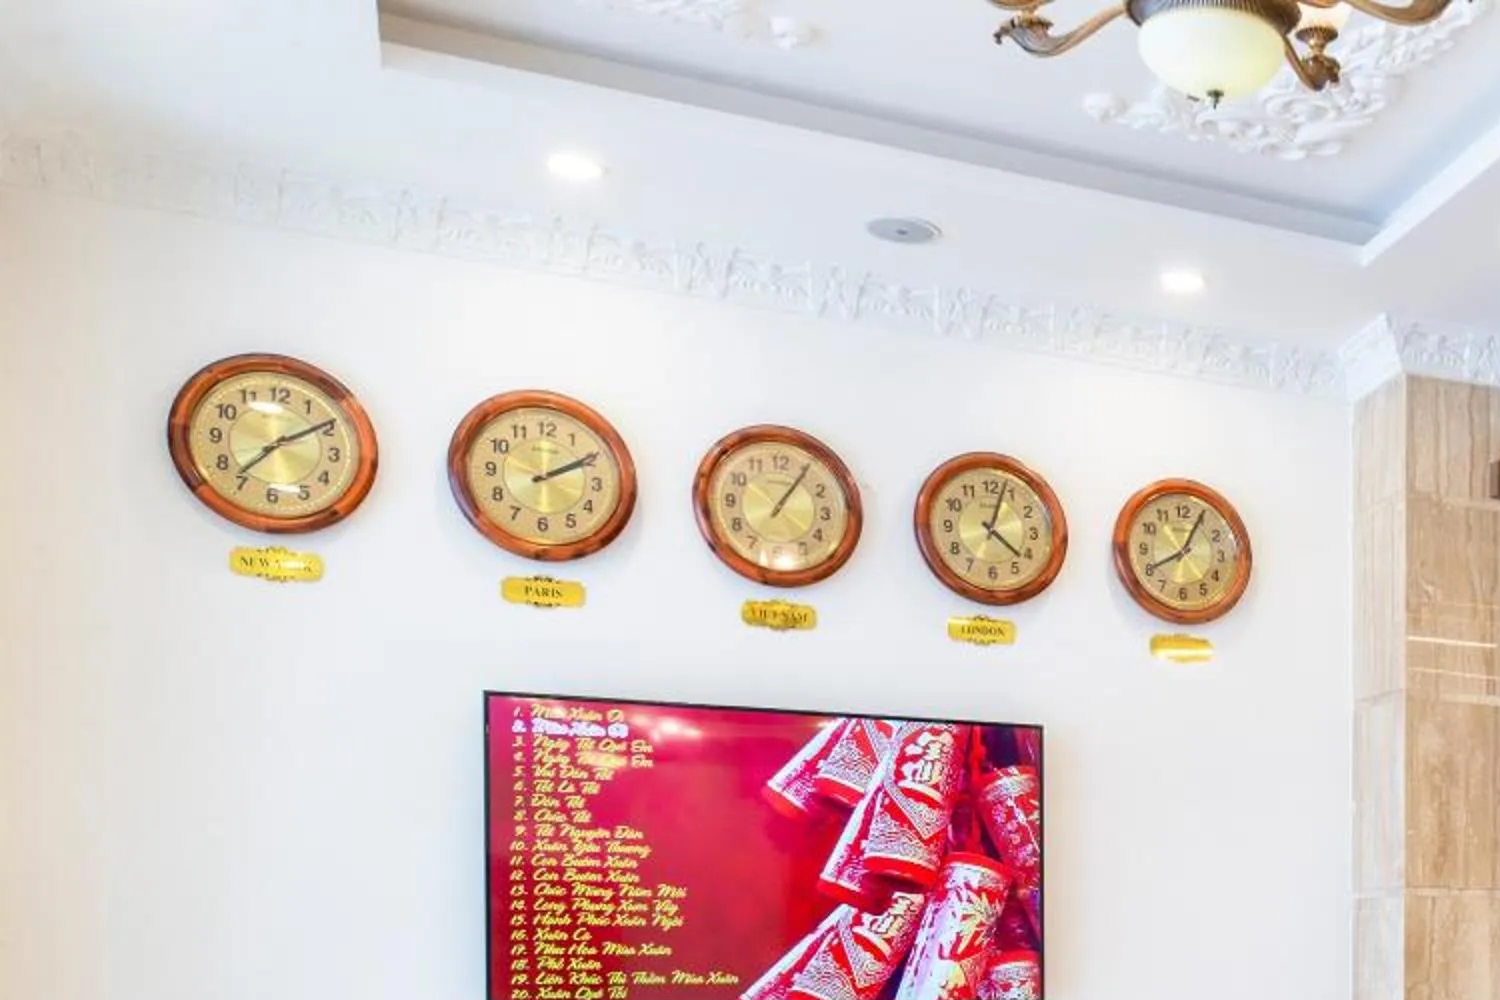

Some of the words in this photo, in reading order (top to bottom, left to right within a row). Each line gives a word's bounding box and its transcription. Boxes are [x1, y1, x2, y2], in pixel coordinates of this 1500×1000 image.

[240, 389, 257, 405] 11
[270, 387, 291, 404] 12
[216, 404, 237, 421] 10
[305, 400, 312, 415] 1
[322, 420, 337, 436] 2
[512, 424, 527, 439] 11
[537, 422, 558, 437] 12
[209, 427, 223, 444] 9
[568, 433, 576, 446] 1
[490, 438, 509, 454] 10
[328, 447, 341, 463] 3
[216, 454, 229, 471] 8
[485, 461, 497, 476] 9
[749, 458, 763, 472] 11
[771, 455, 790, 470] 12
[236, 475, 249, 491] 7
[318, 471, 330, 485] 4
[592, 477, 603, 492] 3
[731, 472, 748, 487] 10
[298, 485, 310, 500] 5
[492, 486, 504, 502] 8
[815, 484, 826, 499] 2
[962, 485, 976, 498] 11
[982, 480, 999, 495] 12
[1007, 487, 1015, 500] 1
[266, 487, 279, 503] 6
[725, 493, 736, 508] 9
[583, 500, 594, 514] 4
[946, 498, 962, 512] 10
[1023, 505, 1033, 519] 2
[509, 506, 522, 520] 7
[820, 507, 831, 521] 3
[1156, 509, 1169, 522] 11
[1175, 506, 1191, 519] 12
[537, 517, 549, 532] 6
[565, 513, 577, 528] 5
[731, 517, 743, 531] 8
[943, 519, 953, 532] 9
[813, 528, 823, 542] 4
[1029, 527, 1039, 541] 3
[1142, 522, 1157, 535] 10
[1211, 529, 1221, 542] 2
[746, 535, 759, 549] 7
[950, 541, 960, 555] 8
[1139, 542, 1148, 555] 9
[1024, 547, 1033, 560] 4
[1217, 550, 1226, 563] 3
[965, 557, 974, 572] 7
[1010, 561, 1020, 575] 5
[1145, 563, 1154, 576] 8
[988, 565, 998, 580] 6
[1211, 569, 1220, 582] 4
[524, 585, 564, 598] PARIS
[1157, 579, 1167, 592] 7
[1199, 583, 1208, 596] 5
[1178, 587, 1188, 601] 6
[961, 624, 1006, 637] LONDON
